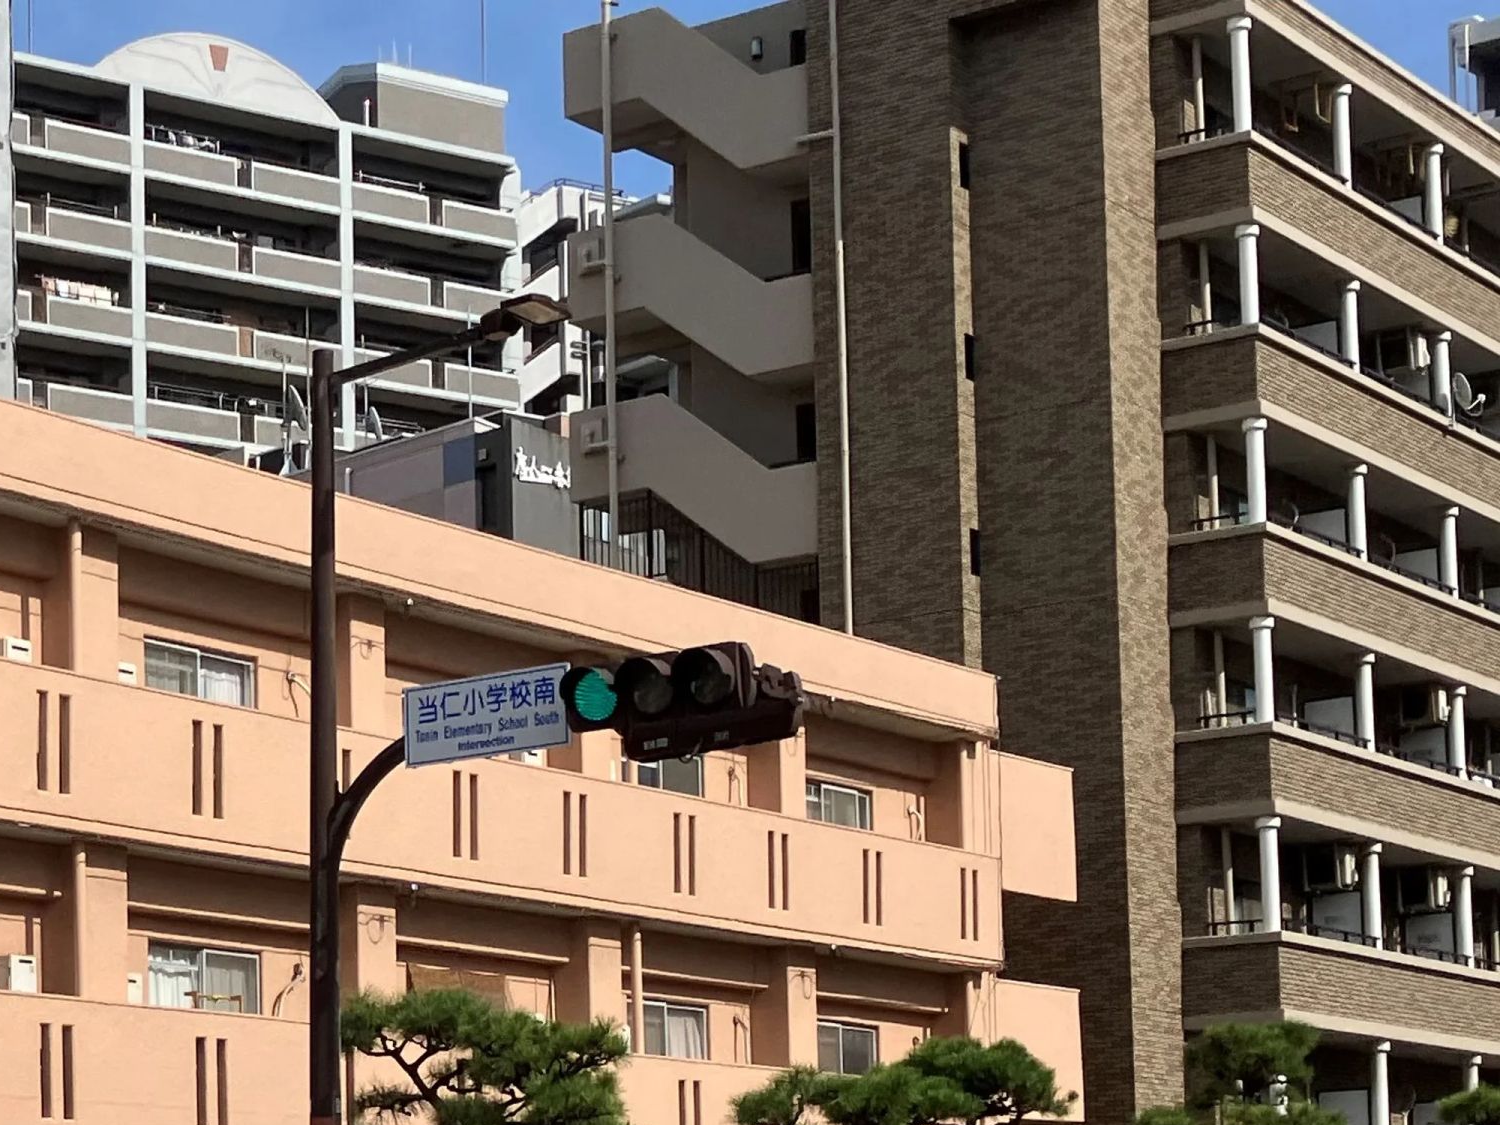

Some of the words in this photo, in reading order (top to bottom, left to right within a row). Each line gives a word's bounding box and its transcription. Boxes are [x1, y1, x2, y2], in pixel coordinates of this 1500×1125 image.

[418, 676, 555, 724] 当仁小学校南
[444, 722, 492, 739] Elementary
[498, 714, 528, 732] School
[534, 711, 560, 727] South
[458, 735, 515, 751] Intersection
